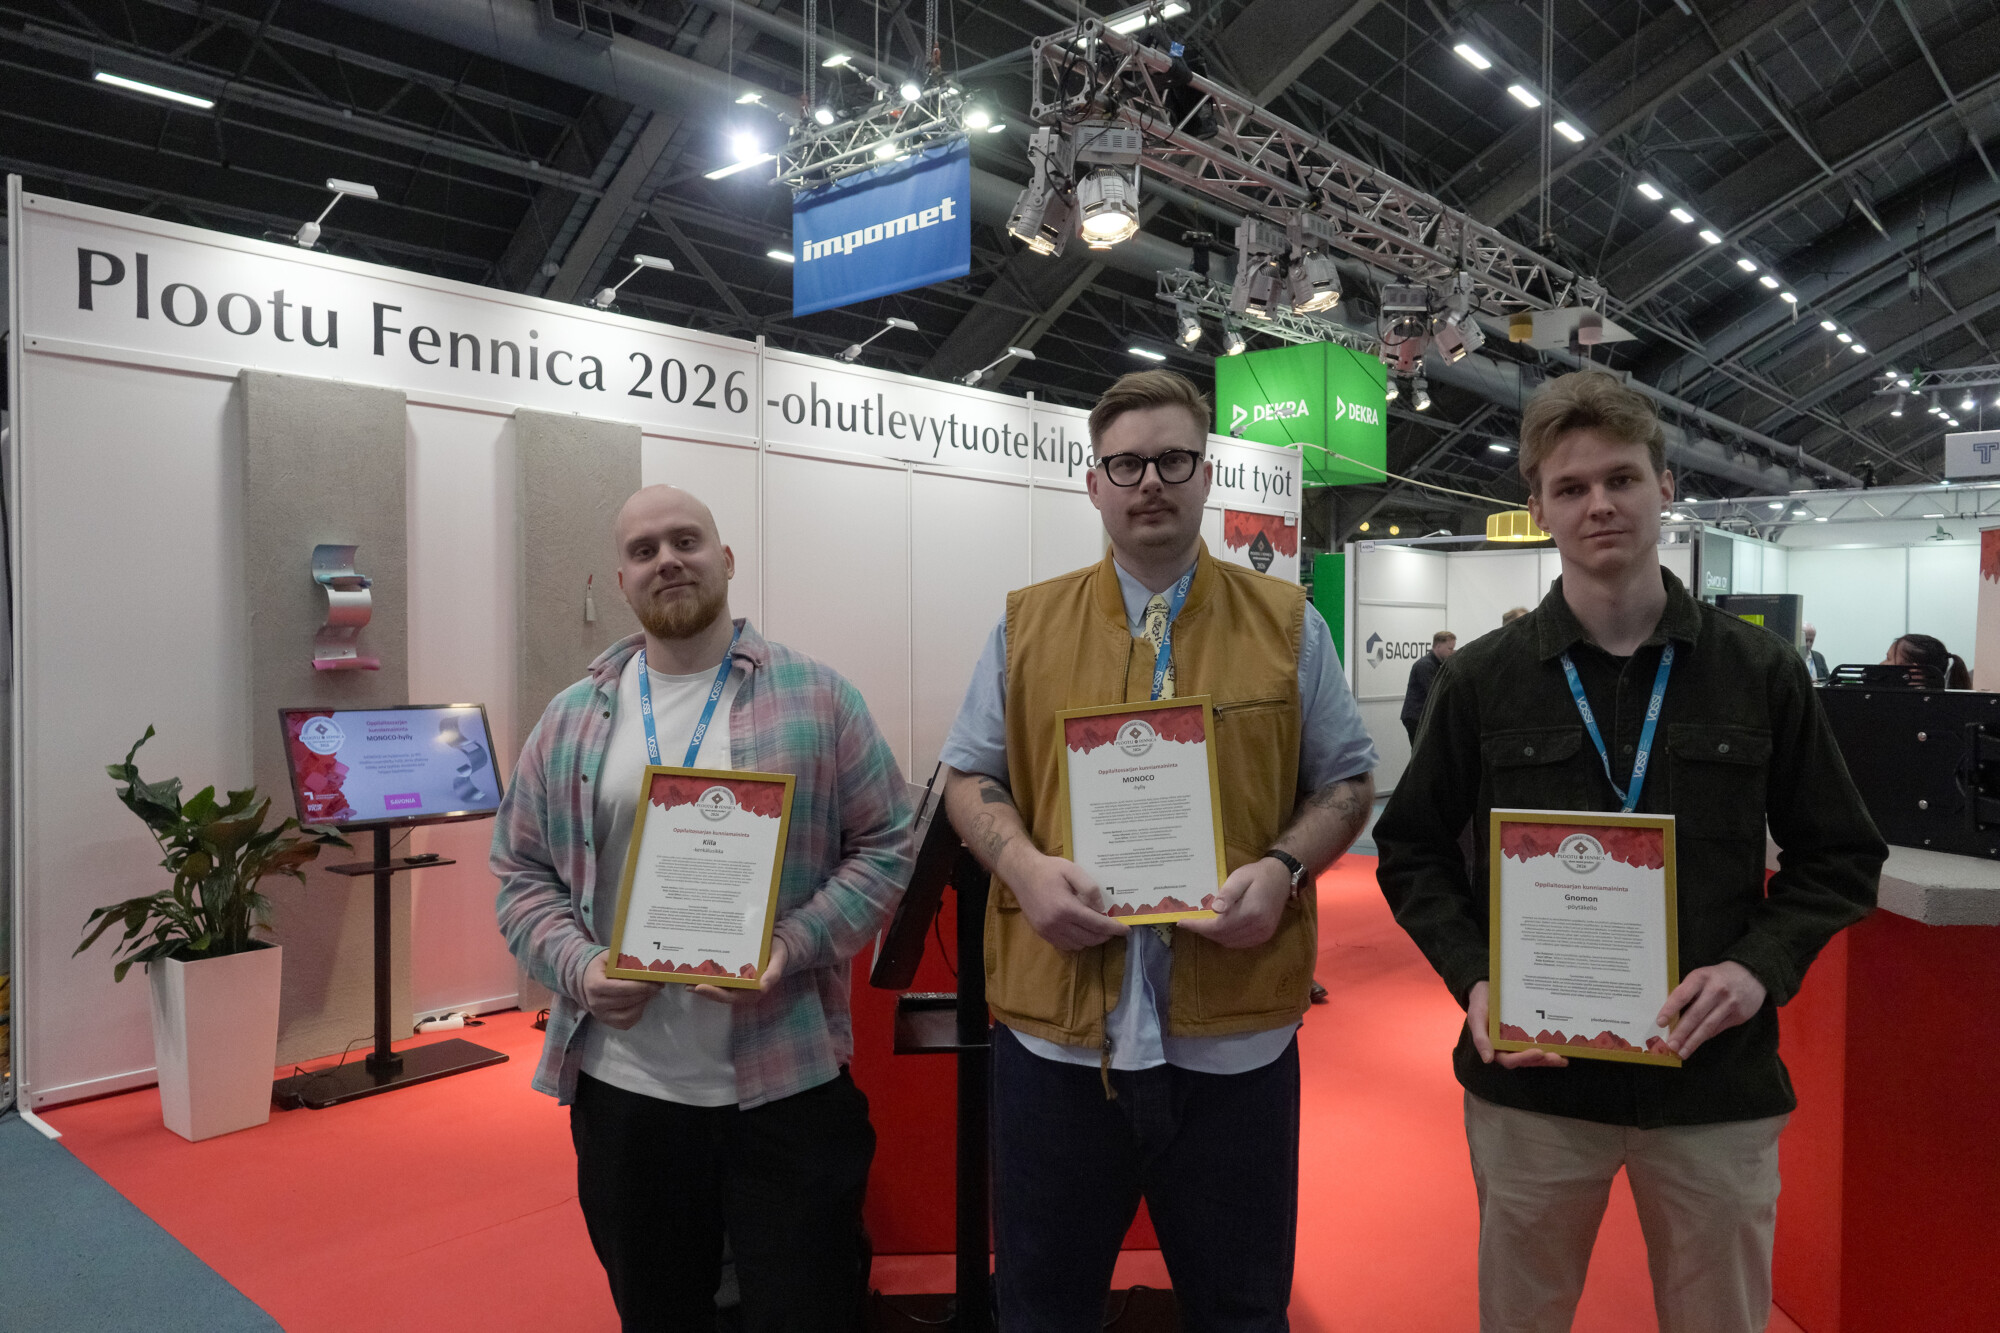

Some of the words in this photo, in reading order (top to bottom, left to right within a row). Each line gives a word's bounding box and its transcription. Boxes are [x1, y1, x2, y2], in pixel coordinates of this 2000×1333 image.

[802, 196, 957, 262] impomet
[77, 247, 339, 349] Plootu
[373, 302, 607, 392] Fennica
[627, 351, 750, 414] 2026
[1210, 454, 1246, 491] tut
[1252, 464, 1293, 504] työt
[1253, 398, 1310, 422] DEKRA
[1348, 402, 1380, 426] DEKRA
[1176, 575, 1190, 598] VOSSI
[710, 680, 724, 702] VOSSI
[1151, 670, 1164, 695] VOSSI
[641, 693, 651, 715] VOSSI
[1577, 696, 1594, 724] VOSSI
[1647, 694, 1662, 721] VOSSI
[691, 723, 707, 746] VOSSI
[647, 735, 658, 758] VOSSI
[1633, 750, 1648, 778] VOSSI
[1122, 774, 1155, 784] MONOCO
[1534, 880, 1582, 890] Oppilaitossarjan
[1582, 883, 1629, 892] kunniamaininta
[1564, 893, 1599, 903] Gnomon
